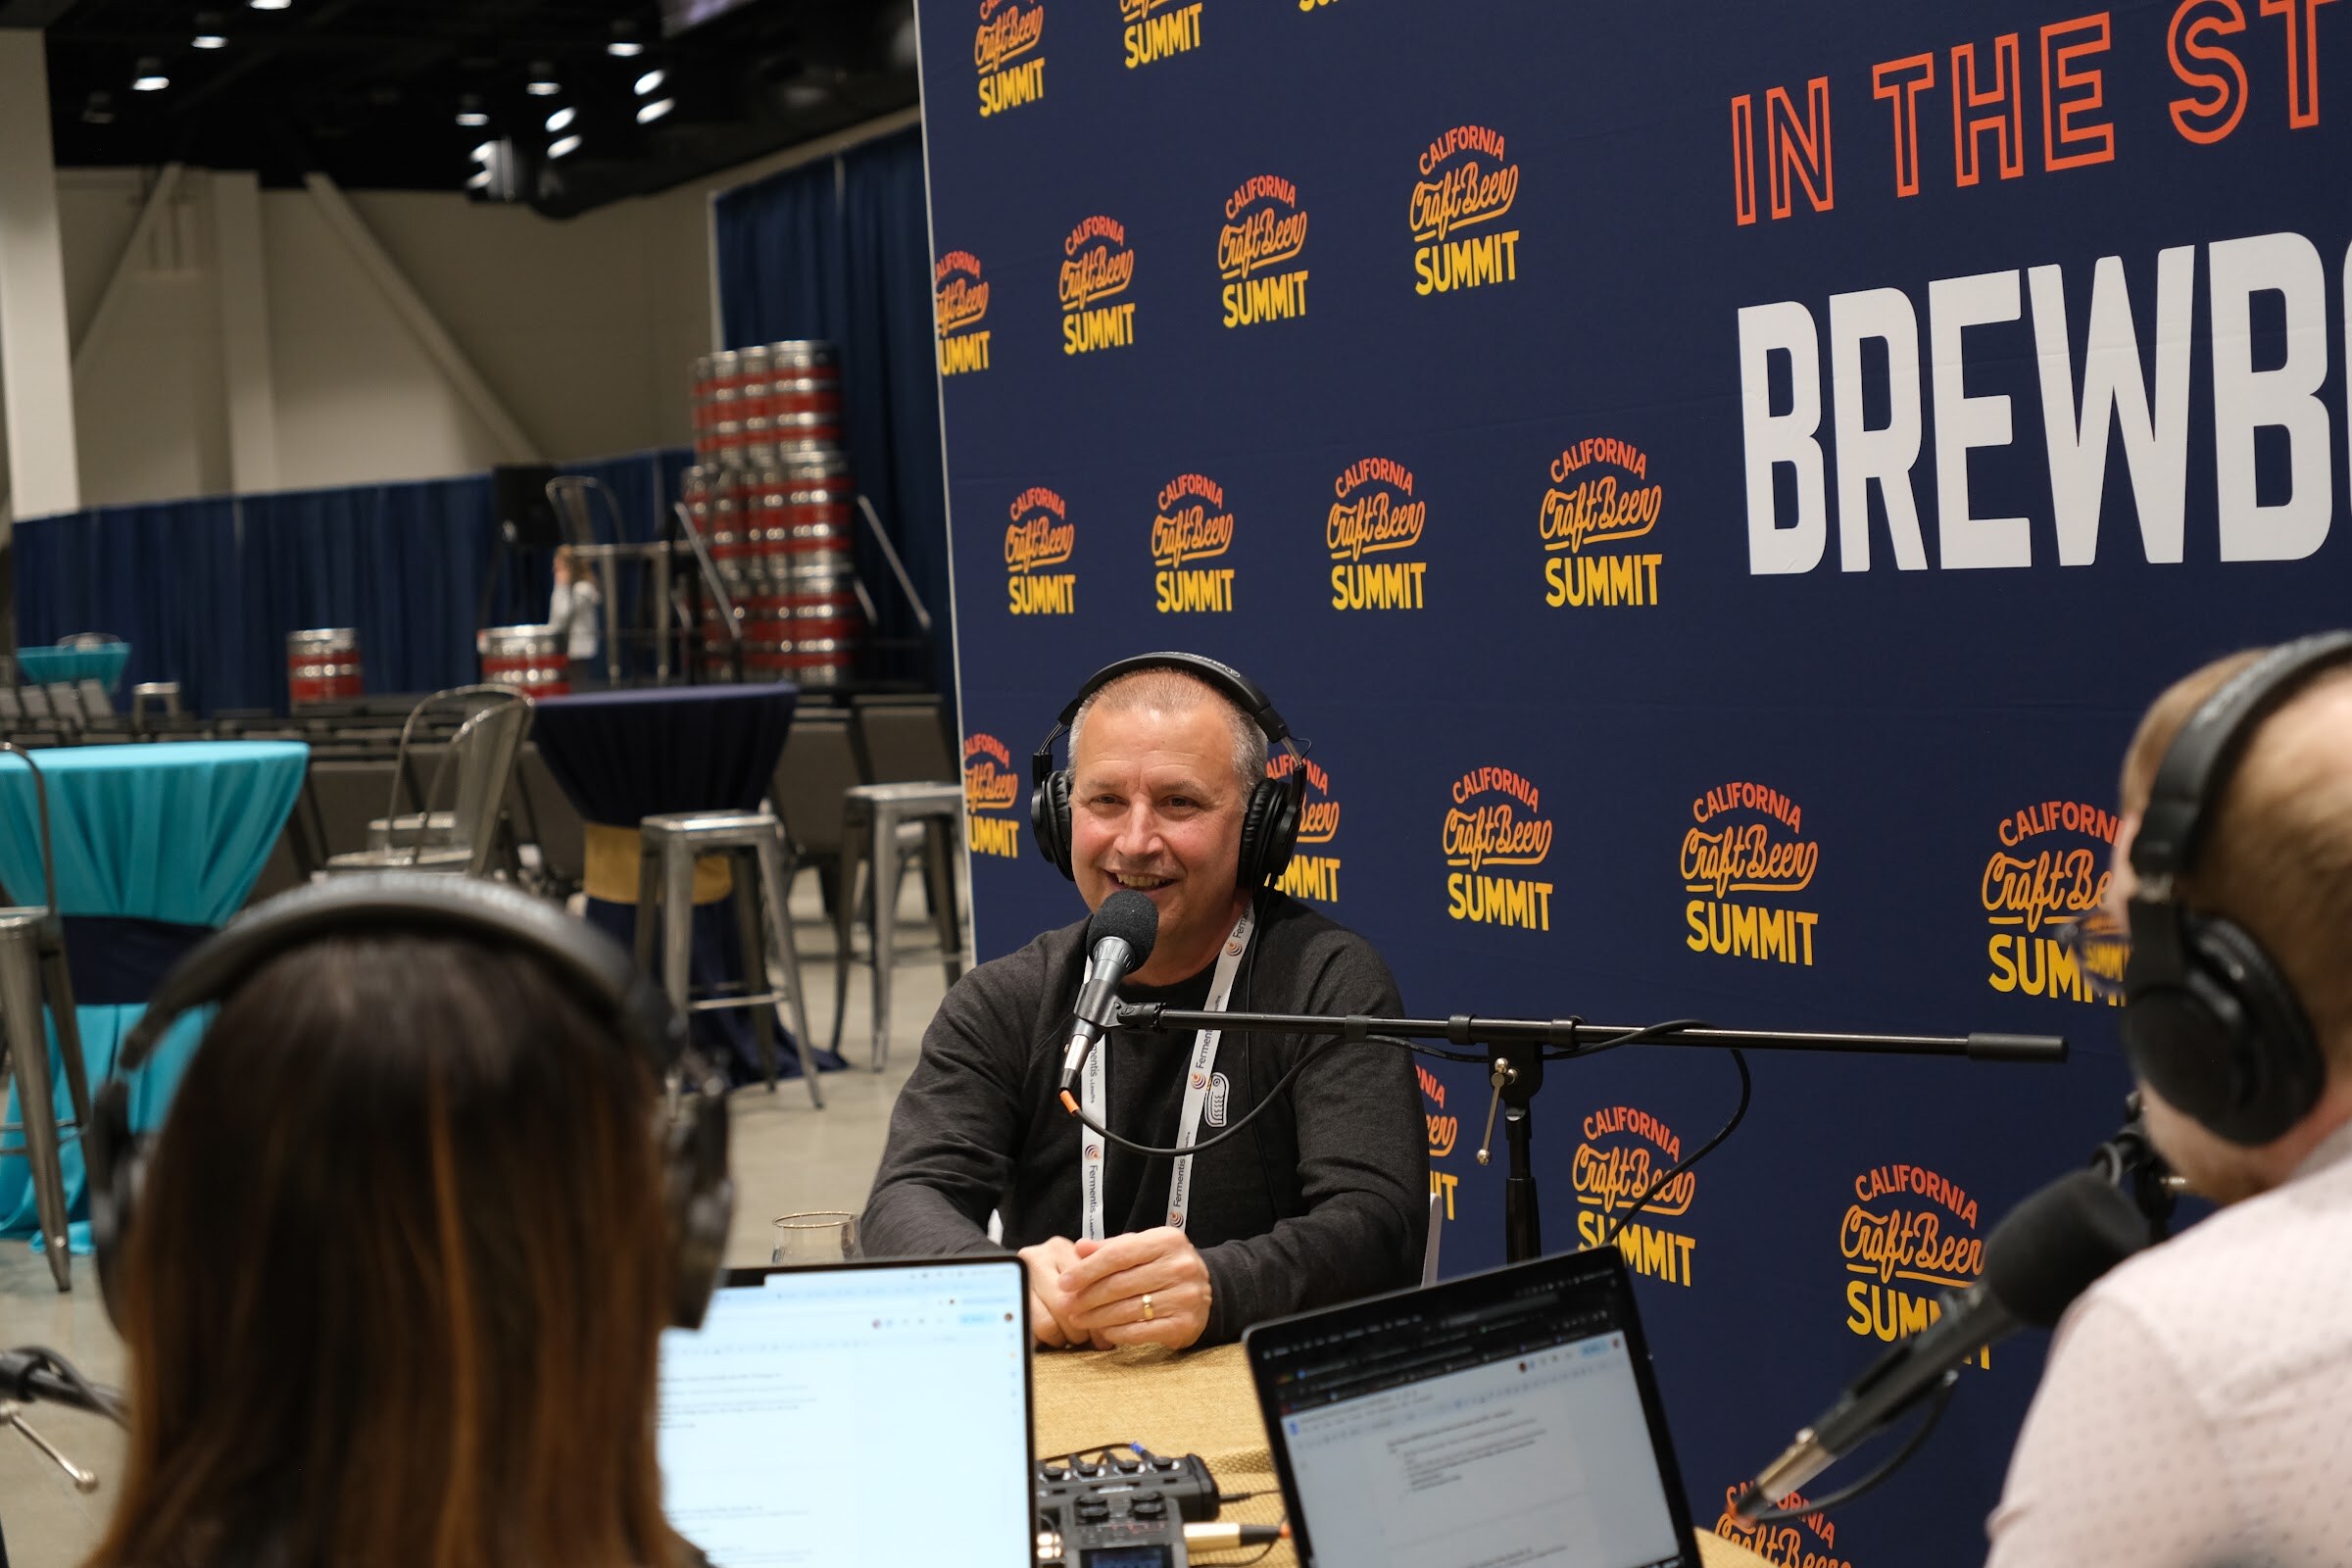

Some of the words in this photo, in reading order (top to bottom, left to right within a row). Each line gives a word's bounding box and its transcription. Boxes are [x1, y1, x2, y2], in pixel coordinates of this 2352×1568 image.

[1124, 2, 1202, 69] SUMMIT
[978, 57, 1046, 117] SUMMIT
[1732, 76, 1834, 226] IN
[1873, 13, 2115, 198] THE
[1419, 125, 1505, 175] CALIFORNIA
[1225, 174, 1297, 220] CALIFORNIA
[1065, 216, 1124, 256] CALIFORNIA
[1414, 230, 1519, 295] SUMMIT
[1222, 270, 1309, 328] SUMMIT
[939, 330, 991, 376] UMMIT
[1063, 303, 1136, 355] SUMMIT
[1738, 231, 2352, 575] BREWB
[1335, 457, 1413, 498] CALIFORNIA
[1550, 437, 1647, 483] CALIFORNIA
[1010, 487, 1065, 521] CALIFORNIA
[1158, 473, 1223, 511] CALIFORNIA
[1008, 574, 1076, 614] SUMMIT
[1155, 569, 1234, 612] SUMMIT
[1331, 563, 1427, 611] SUMMIT
[1544, 554, 1663, 608] SUMMIT
[1452, 767, 1540, 813] CALIFORNIA
[1693, 782, 1801, 834] CALIFORNIA
[968, 814, 1019, 858] UMMIT
[1447, 872, 1553, 931] SUMMIT
[1687, 900, 1819, 966] SUMMIT
[1584, 1106, 1680, 1162] CALIFORNIA
[1090, 1164, 1099, 1213] Fermentis
[1173, 1158, 1185, 1207] Fermentis
[1855, 1164, 1979, 1230] CALIFORNIA
